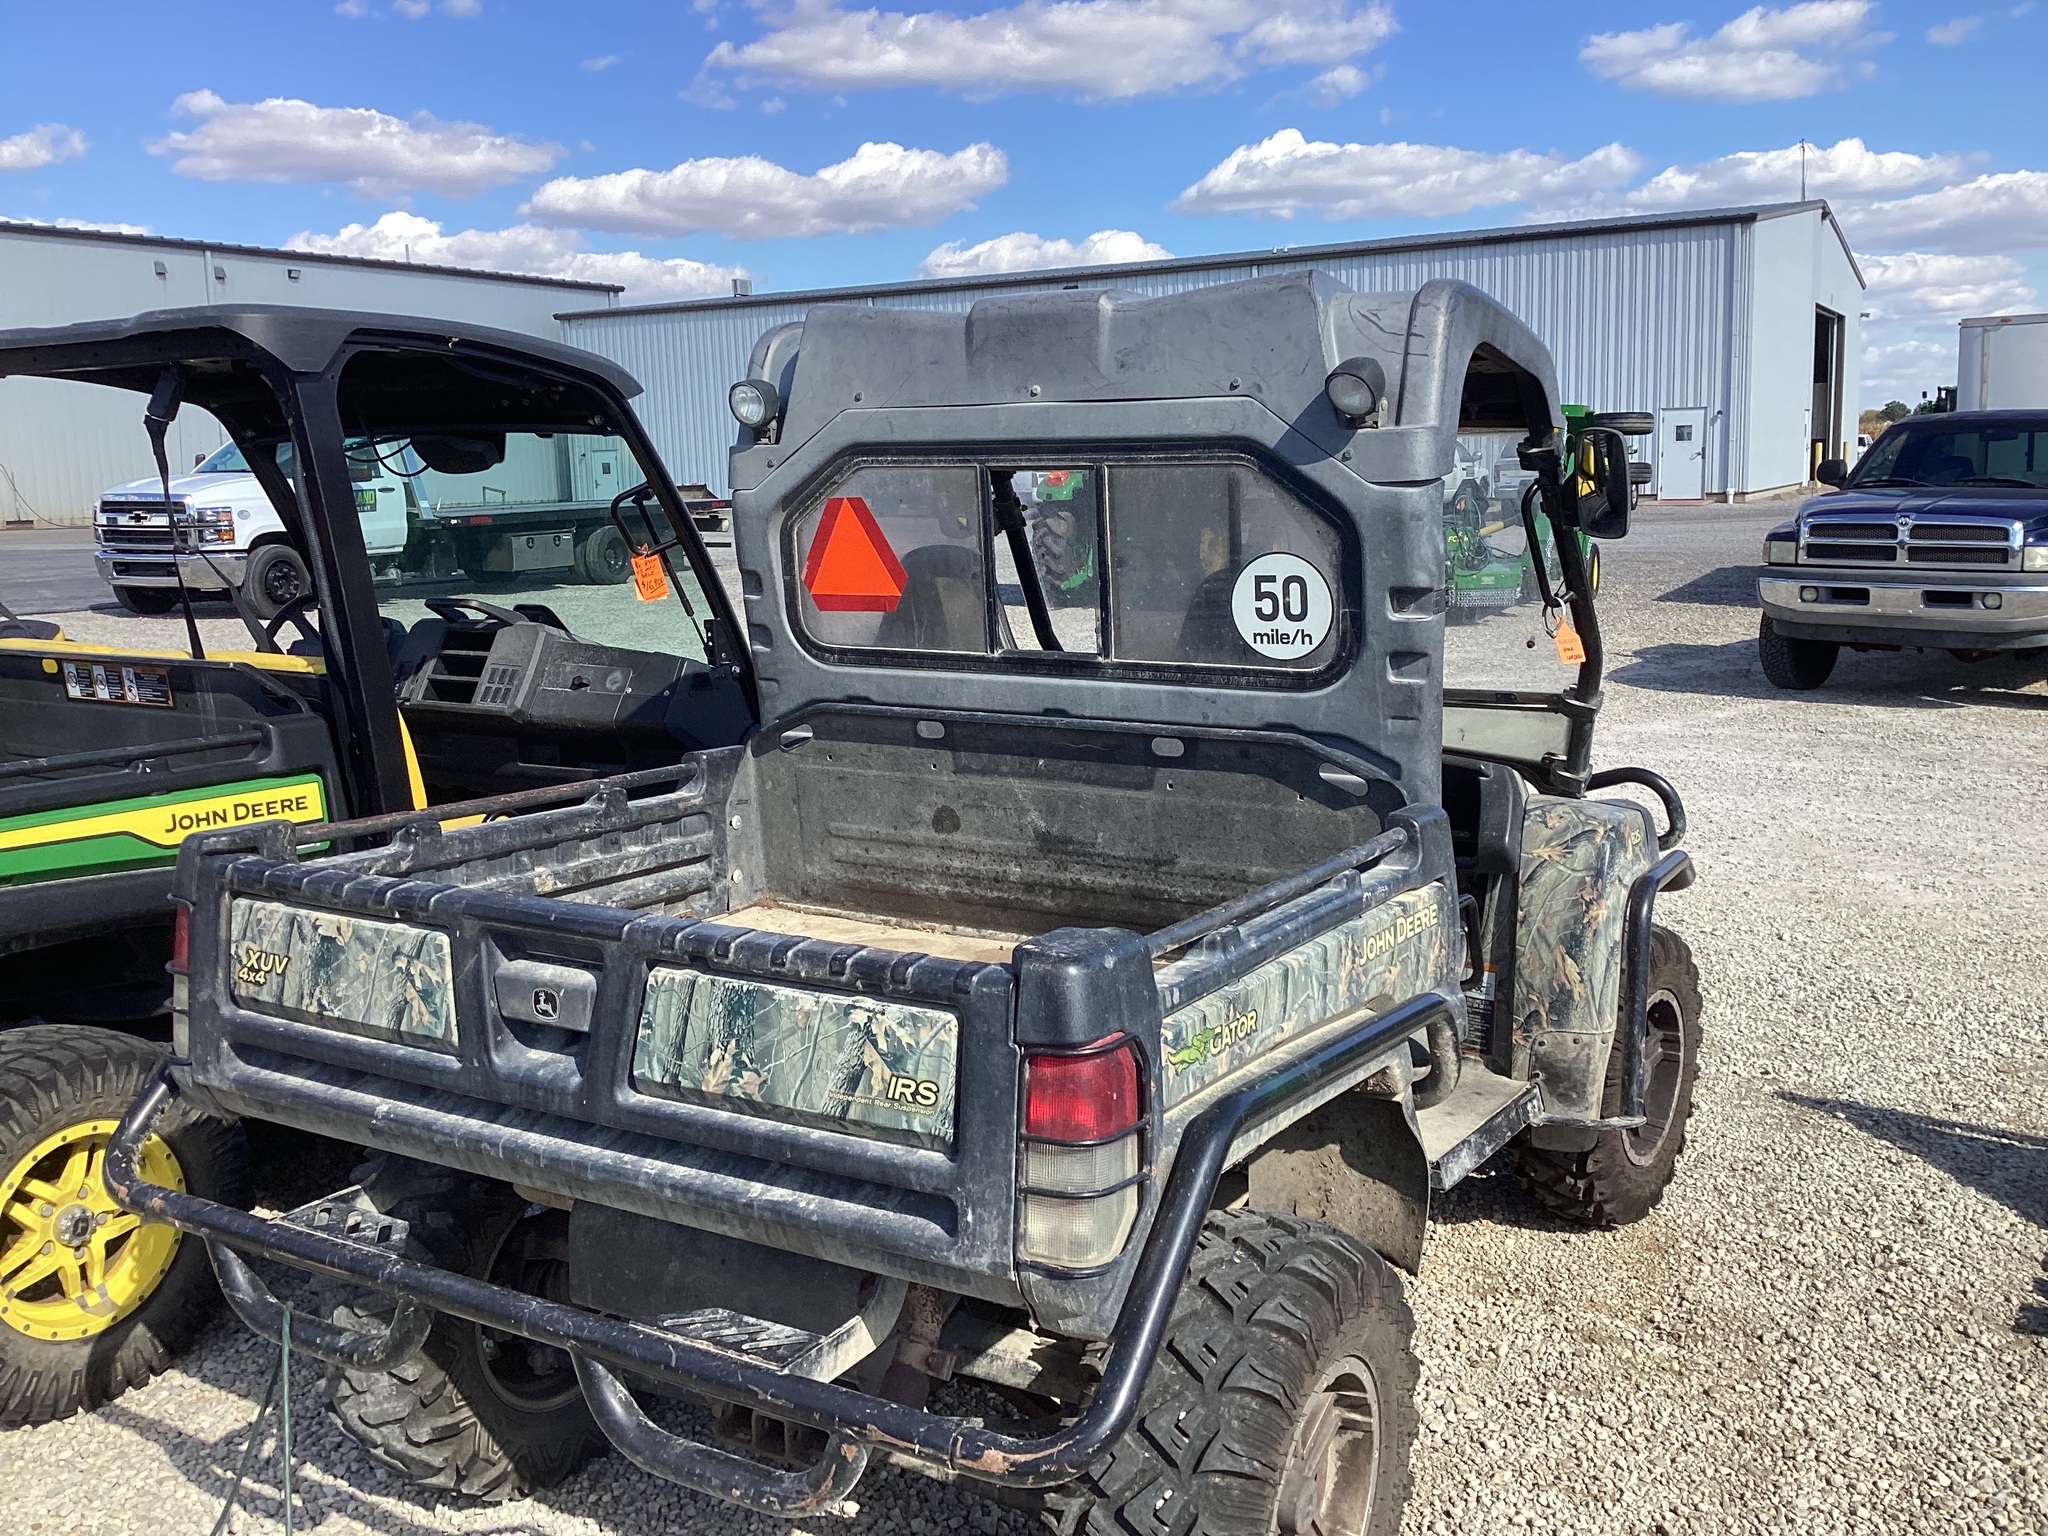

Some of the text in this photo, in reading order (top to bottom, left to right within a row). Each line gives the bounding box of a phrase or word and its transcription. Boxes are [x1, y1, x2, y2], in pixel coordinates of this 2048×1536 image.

[354, 490, 376, 504] AND
[1254, 574, 1309, 623] 50
[1253, 628, 1313, 646] mile/h
[164, 795, 308, 833] JOHN DEERE
[1359, 904, 1438, 966] JOHN DEERE
[238, 967, 266, 985] 4x4
[245, 949, 290, 975] XUV
[1210, 1009, 1258, 1056] GATOR
[828, 1091, 935, 1116] Independent Rear Suspension
[886, 1075, 939, 1107] IRS
